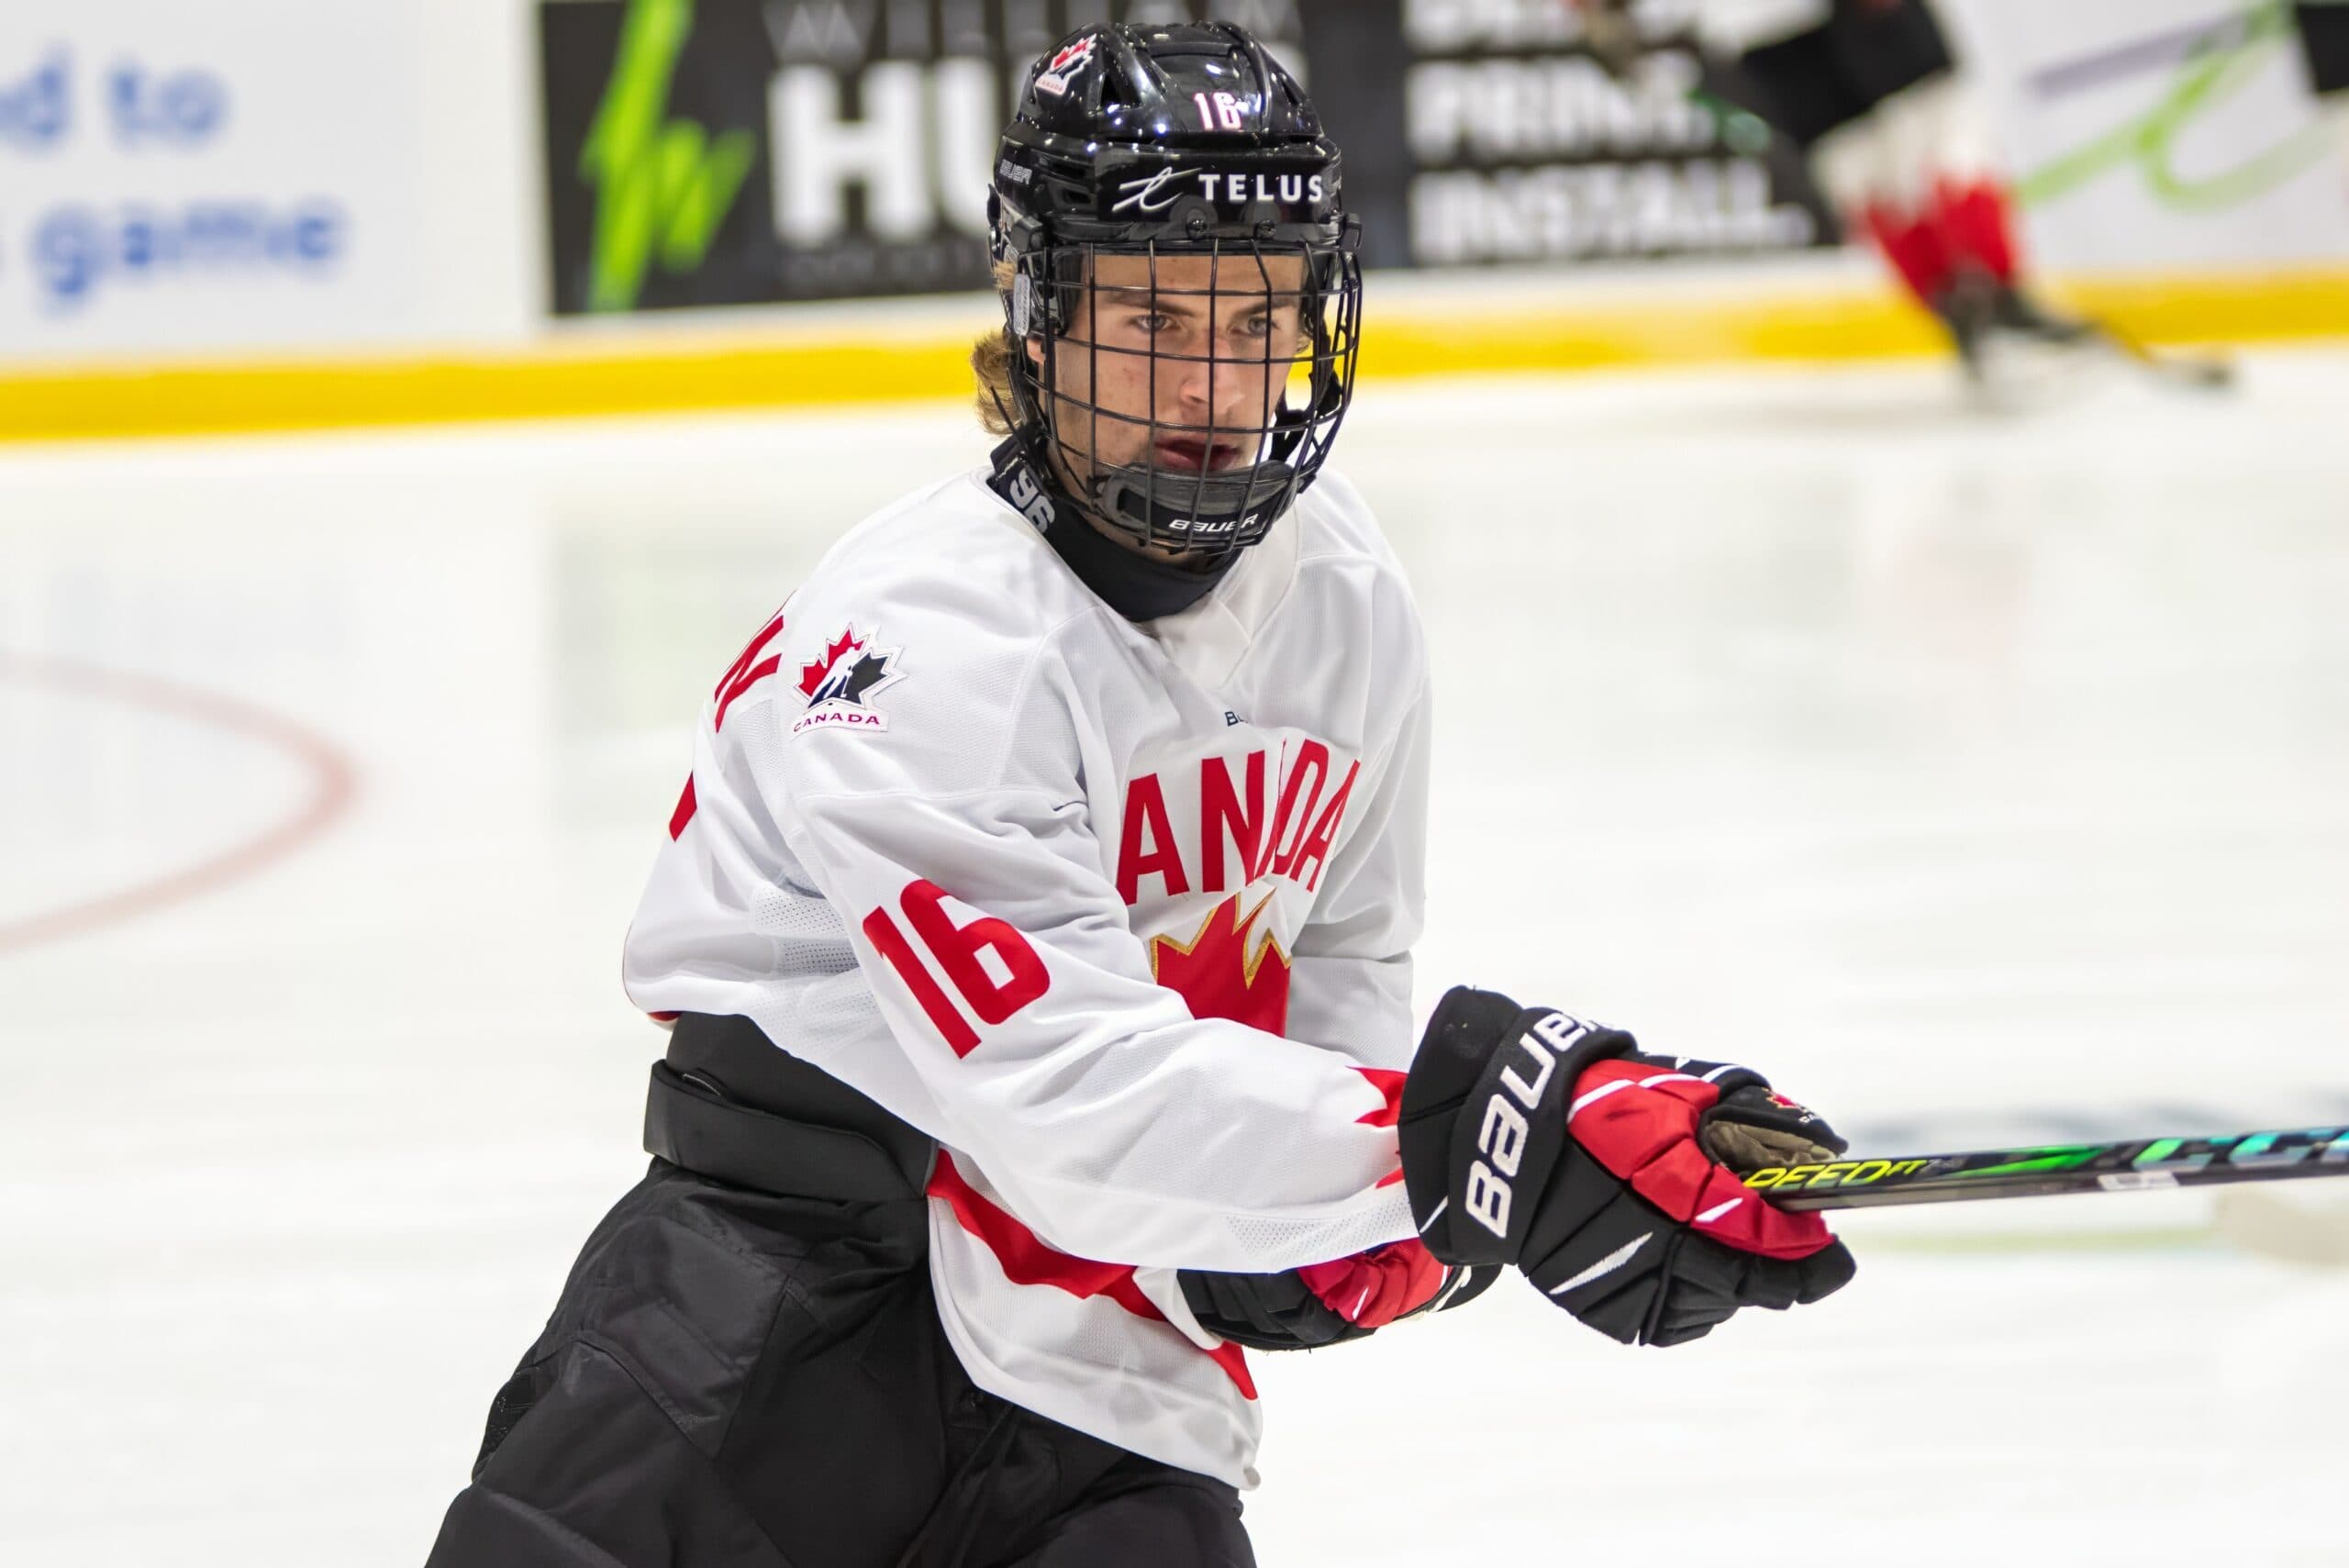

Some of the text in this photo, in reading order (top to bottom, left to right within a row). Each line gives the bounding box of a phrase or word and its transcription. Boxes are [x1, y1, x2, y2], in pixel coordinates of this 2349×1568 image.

[1193, 91, 1241, 131] 16
[1198, 172, 1323, 203] TELUS
[793, 711, 880, 733] CANADA
[1116, 738, 1361, 906] ANDA
[863, 878, 1051, 1060] 16
[1743, 1160, 1892, 1191] PEED
